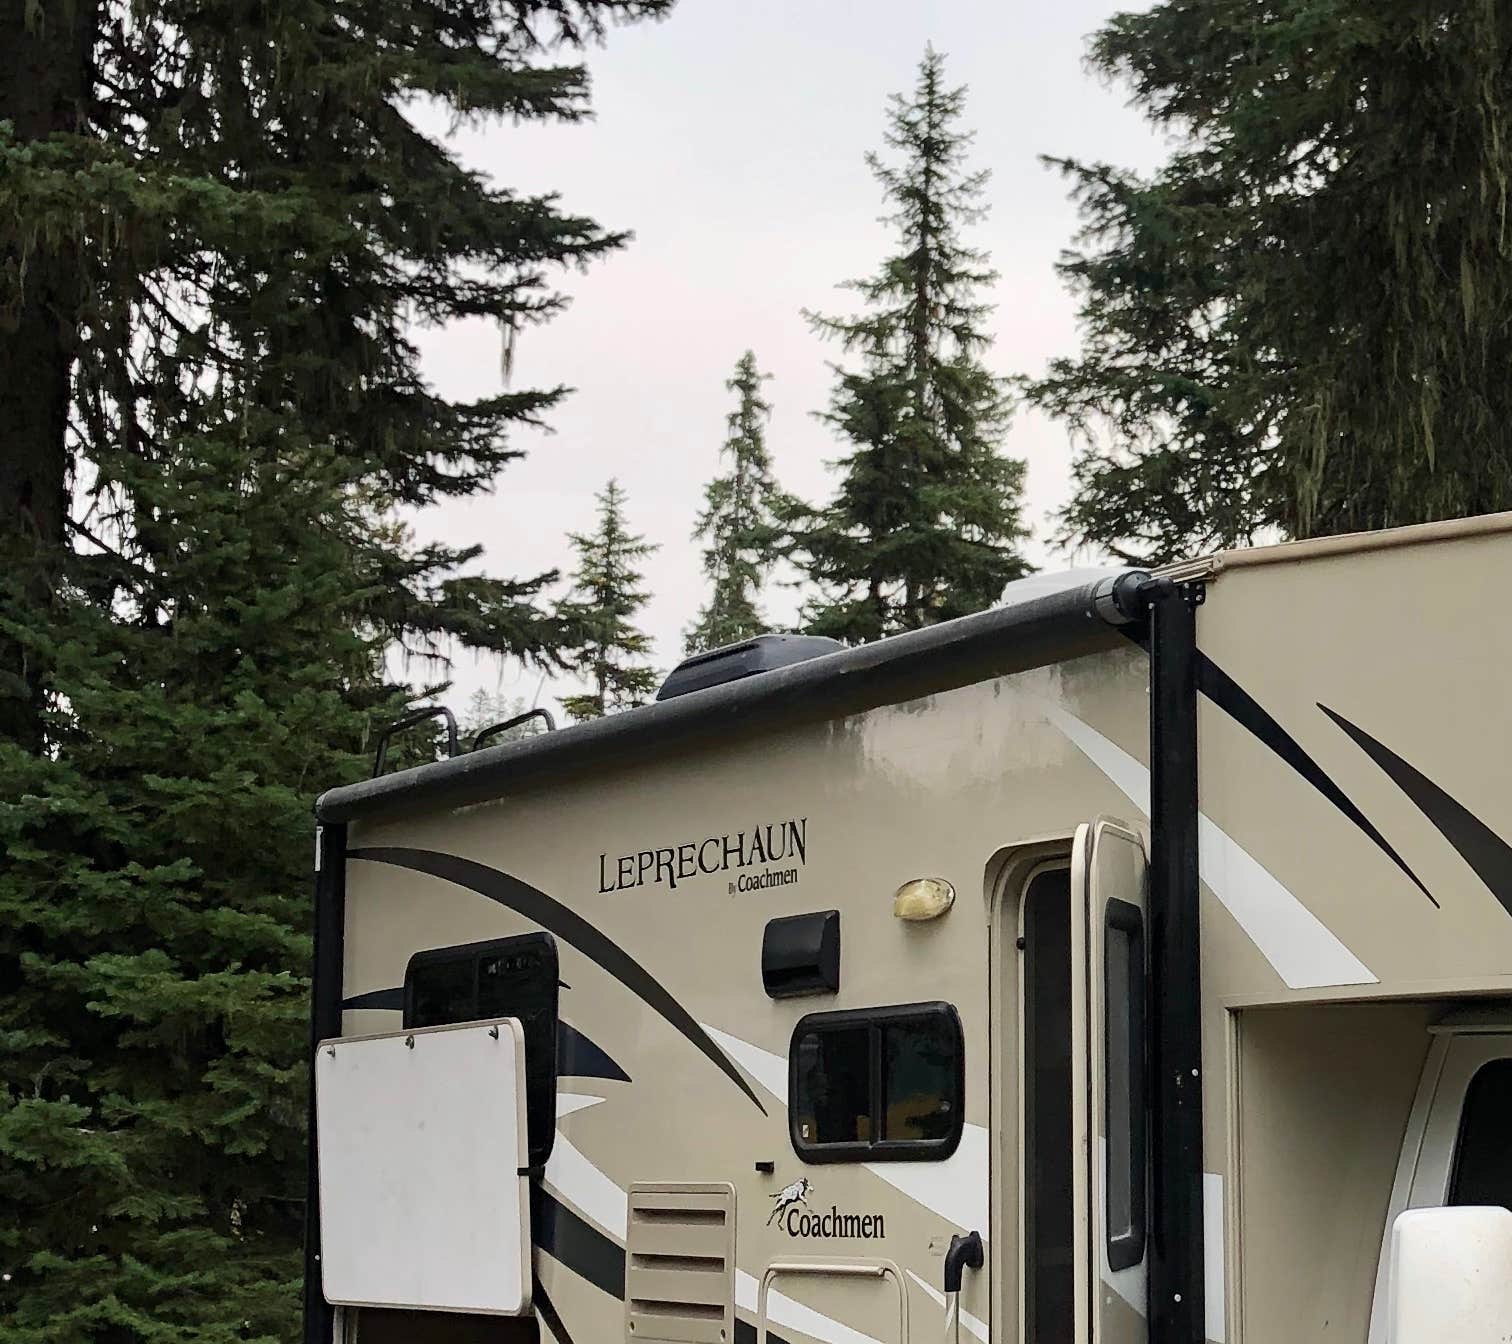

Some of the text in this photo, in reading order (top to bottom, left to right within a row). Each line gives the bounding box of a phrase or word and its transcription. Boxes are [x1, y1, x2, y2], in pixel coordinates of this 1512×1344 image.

[598, 816, 808, 894] LEPRECHAUN
[737, 867, 798, 894] Coachmen
[786, 1205, 886, 1239] Coachmen
